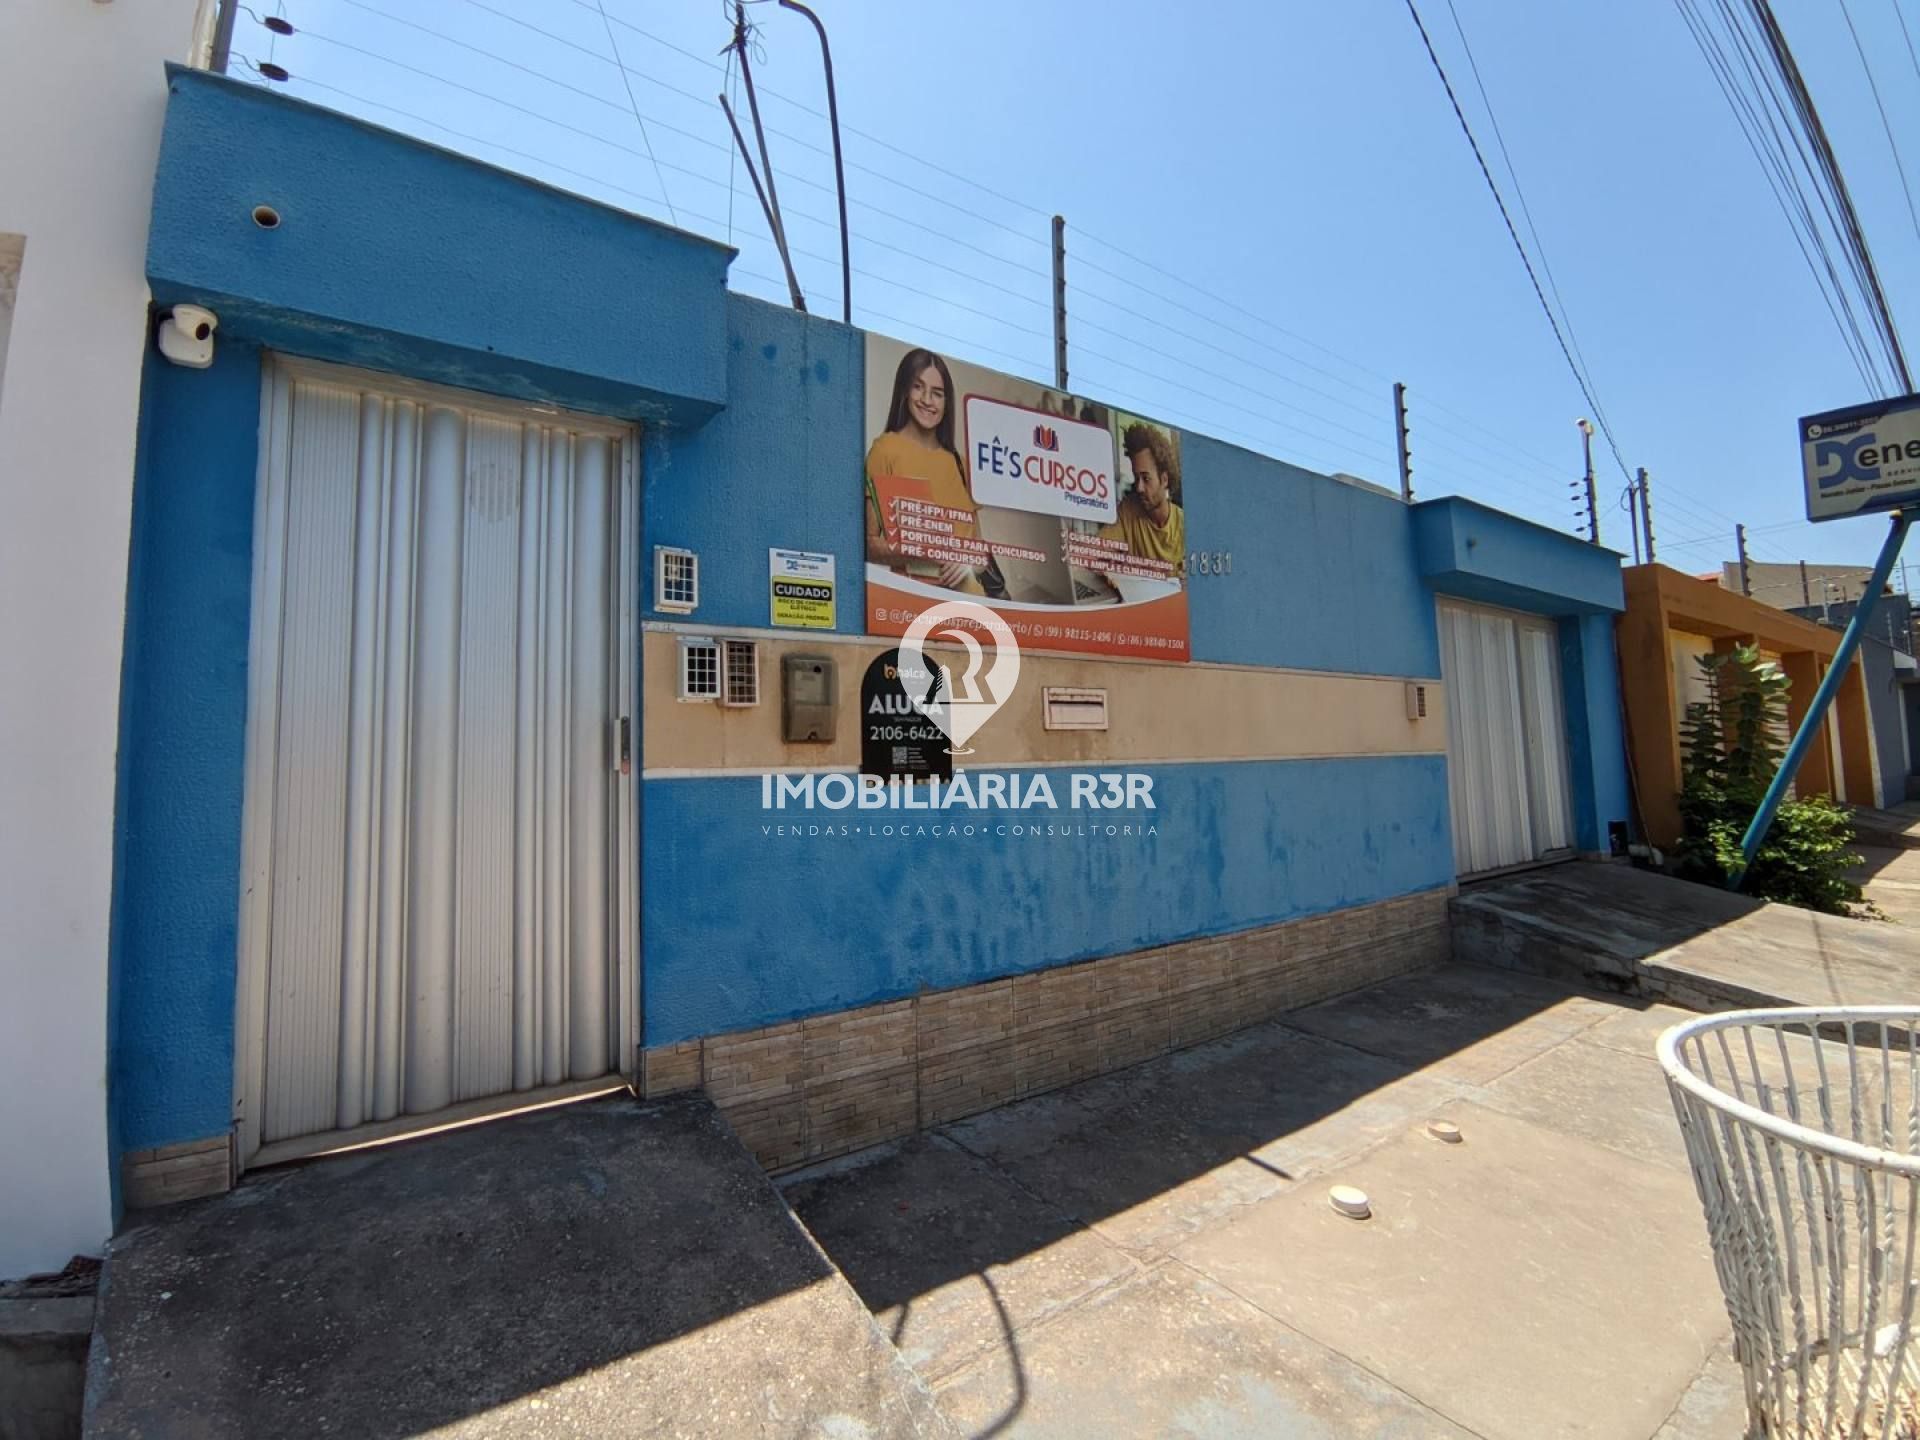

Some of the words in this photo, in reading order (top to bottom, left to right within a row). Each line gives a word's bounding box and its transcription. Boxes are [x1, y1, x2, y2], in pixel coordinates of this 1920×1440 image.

[1024, 455, 1108, 499] CURSOS
[900, 515, 953, 533] PRÉ-ENEM
[1069, 532, 1100, 546] CURSOS
[1103, 539, 1129, 551] LIVRES
[927, 549, 989, 566] CONCURSOS
[964, 541, 989, 553] PARA
[991, 544, 1046, 562] CONCURSOS
[1069, 544, 1125, 562] PROFISSIONAIS
[1126, 555, 1174, 570] QUALIFICADOS
[1070, 556, 1089, 568] SALA
[1189, 552, 1232, 575] 1831
[775, 584, 830, 598] CUIDADO
[868, 693, 945, 715] ALUGA
[870, 725, 945, 741] 2106-6422
